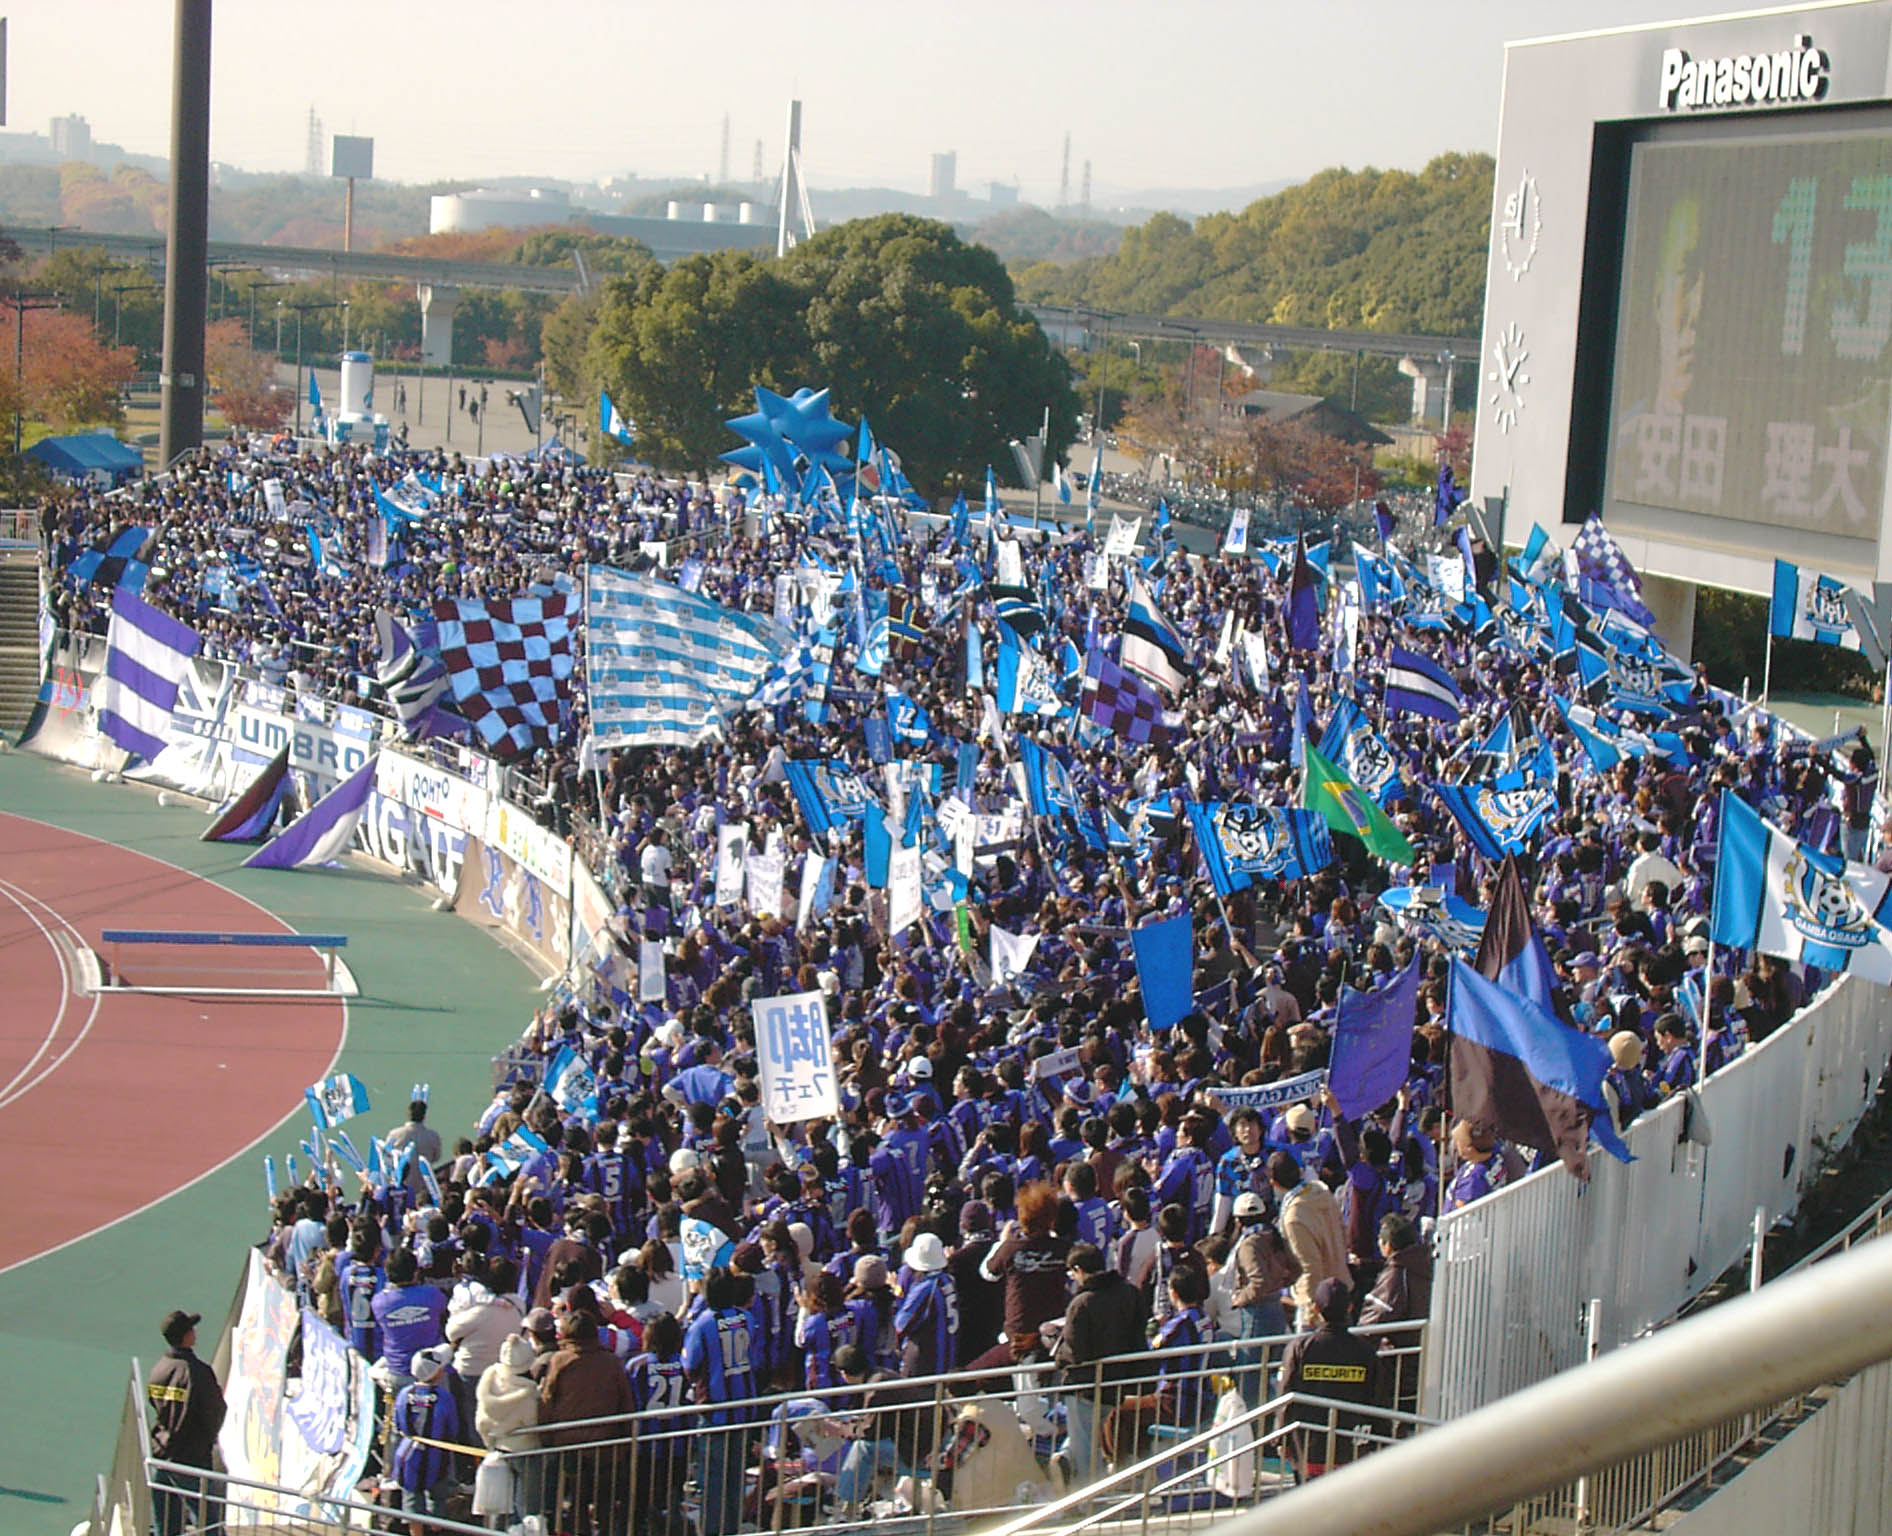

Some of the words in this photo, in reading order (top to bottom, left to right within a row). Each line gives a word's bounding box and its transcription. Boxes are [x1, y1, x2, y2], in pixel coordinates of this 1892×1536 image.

[1659, 33, 1823, 109] Panasonic
[1634, 412, 1728, 507] 安田
[412, 773, 450, 808] ROHTO
[1794, 916, 1827, 938] GAMBA
[1828, 930, 1868, 945] OSAKA
[604, 1166, 621, 1196] 5
[1094, 1216, 1107, 1250] 5
[351, 1288, 371, 1321] 6
[945, 1293, 960, 1334] 5
[719, 1327, 751, 1369] 10
[1305, 1367, 1364, 1379] SECURITY
[646, 1375, 684, 1411] 21
